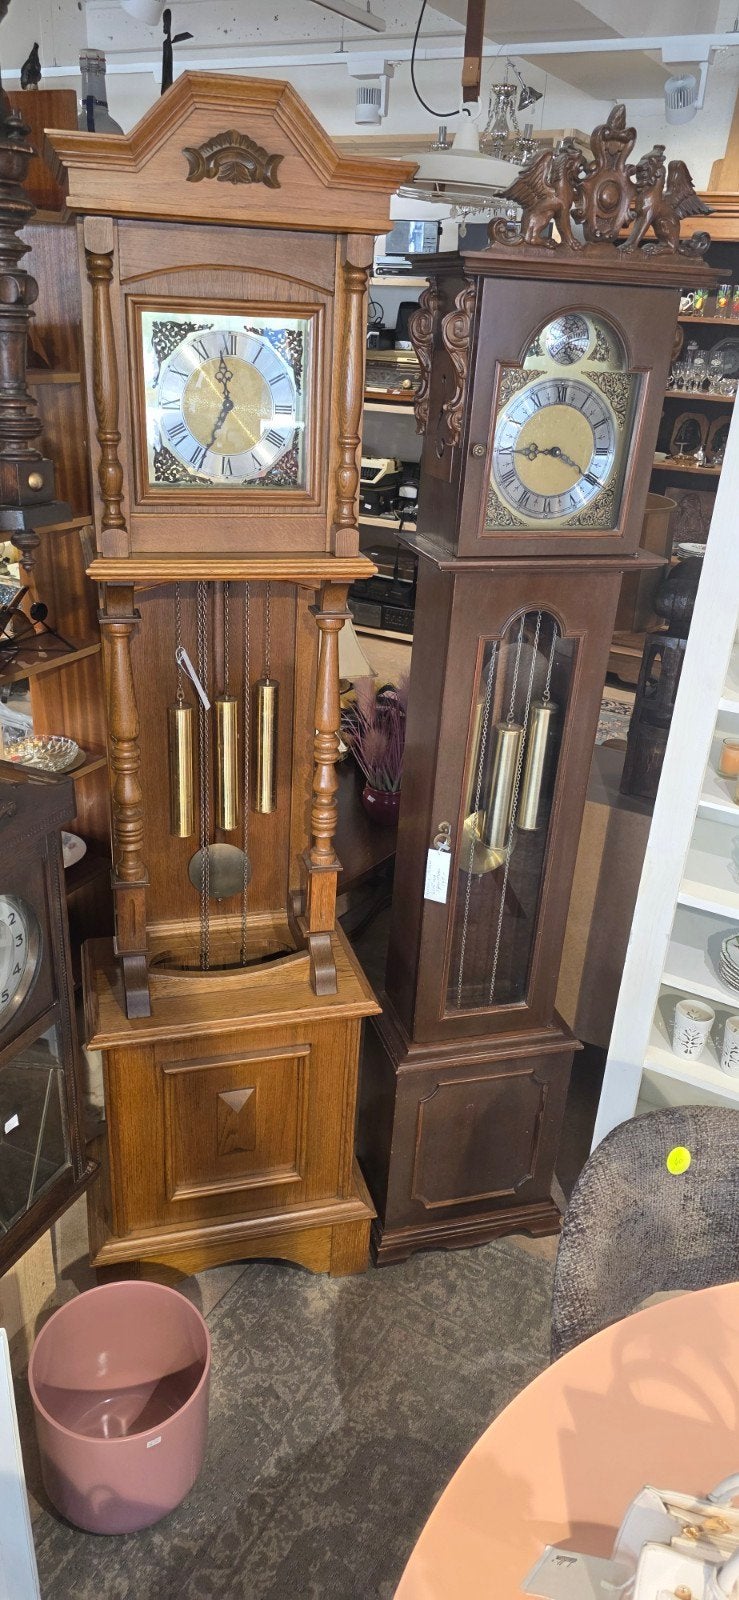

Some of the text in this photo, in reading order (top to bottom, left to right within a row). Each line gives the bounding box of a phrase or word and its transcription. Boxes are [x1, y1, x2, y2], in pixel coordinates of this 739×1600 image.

[252, 346, 263, 364] I
[268, 372, 286, 386] II
[556, 386, 568, 403] XII
[275, 404, 292, 415] III
[593, 419, 607, 430] II
[167, 422, 188, 447] VIII
[265, 429, 285, 449] IIII
[595, 447, 608, 456] III
[221, 456, 233, 475] VI
[501, 469, 516, 489] VIII
[8, 912, 16, 926] 2
[15, 933, 23, 948] 3
[12, 962, 21, 976] 4
[1, 989, 10, 1003] 5
